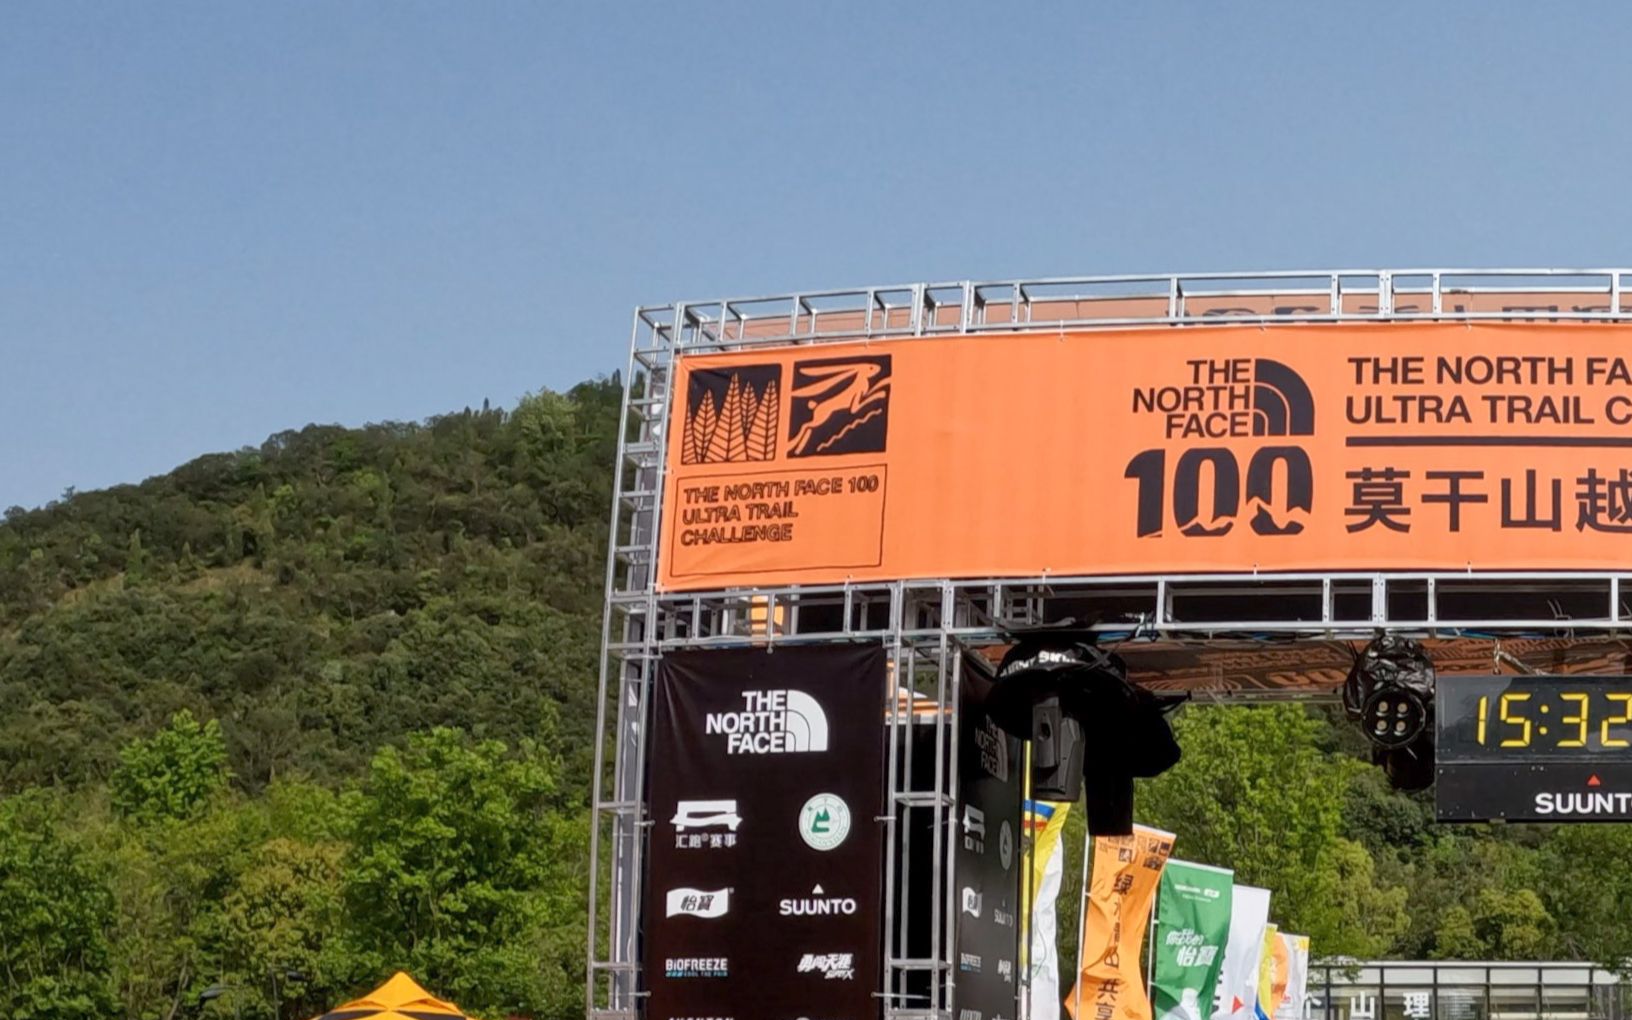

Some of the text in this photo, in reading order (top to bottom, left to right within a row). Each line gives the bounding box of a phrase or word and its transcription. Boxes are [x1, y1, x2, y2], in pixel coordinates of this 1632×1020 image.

[1187, 358, 1251, 384] THE
[1348, 356, 1425, 385] THE
[1436, 355, 1574, 385] NORTH
[1132, 385, 1250, 413] NORTH
[1346, 395, 1471, 424] ULTRA
[1482, 396, 1594, 424] TRAIL
[1165, 411, 1250, 439] FACE
[684, 475, 879, 504] THE NORTH FACE 100
[1124, 445, 1313, 538] 100
[682, 501, 799, 525] ULTRA TRAIL
[681, 523, 793, 546] CHALLENGE
[742, 690, 786, 712] THE
[706, 711, 785, 734] NORTH
[728, 732, 785, 755] FACE
[779, 898, 856, 915] SUUNTO
